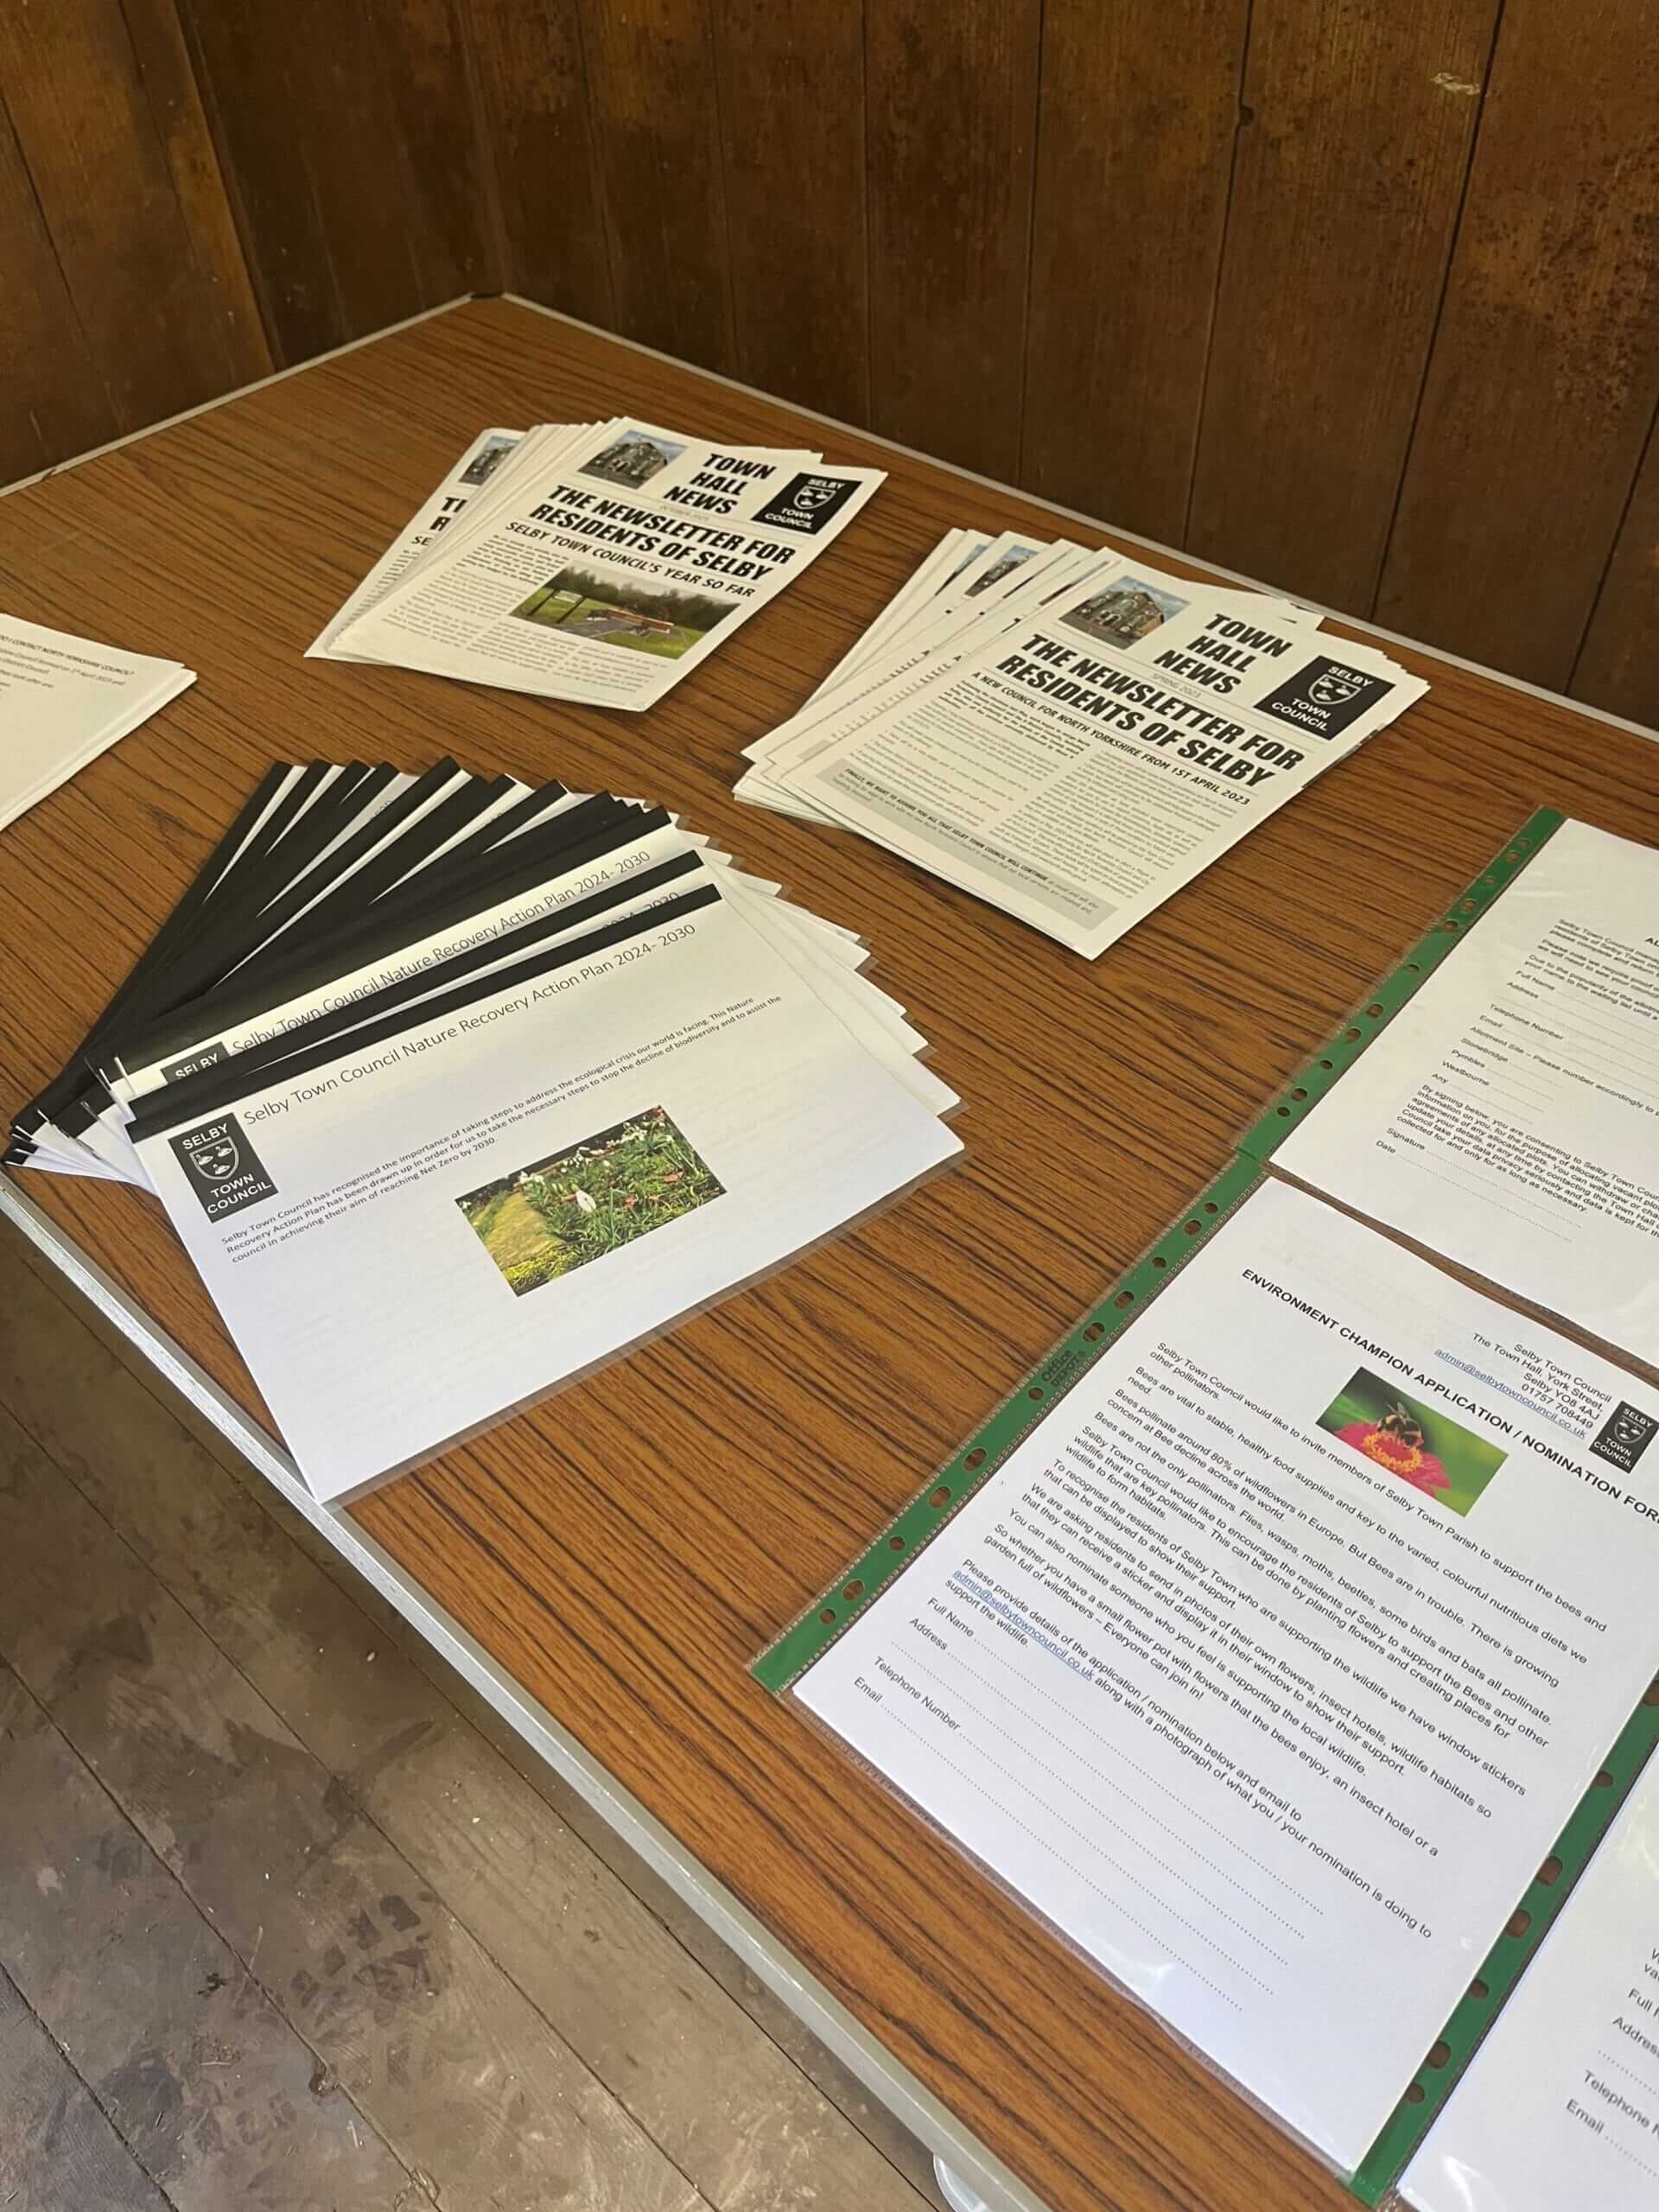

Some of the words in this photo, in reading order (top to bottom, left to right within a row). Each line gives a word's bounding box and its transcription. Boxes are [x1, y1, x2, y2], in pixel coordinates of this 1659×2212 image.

[702, 453, 777, 480] TOWN
[663, 486, 738, 514] NEWS
[690, 472, 747, 496] HALL
[807, 478, 845, 489] SELBY
[548, 485, 598, 510] THE
[591, 499, 746, 551] NEWSLETTER
[742, 539, 796, 564] FOR
[765, 512, 812, 529] COUNCIL
[781, 507, 815, 520] TOWN
[529, 504, 662, 552] RESIDENTS
[658, 542, 697, 561] OF
[690, 550, 774, 581] SELBY
[505, 522, 551, 540] SELBY
[550, 535, 593, 553] TOWN
[592, 548, 663, 573] COUNCIL'S
[664, 567, 702, 583] YEAR
[702, 578, 725, 589] SO
[725, 583, 756, 597] FAR
[1205, 613, 1293, 658] TOWN
[1186, 635, 1256, 673] HALL
[1154, 649, 1242, 694] NEWS
[1328, 666, 1374, 687] SELBY
[1020, 633, 1078, 668] THE
[1067, 658, 1245, 745] NEWSLETTER
[1237, 734, 1305, 771] FOR
[1271, 702, 1327, 731] COUNCIL
[1292, 697, 1332, 720] TOWN
[995, 654, 1146, 731] RESIDENTS
[1139, 722, 1186, 747] OF
[1177, 739, 1276, 787] SELBY
[980, 675, 1003, 689] NEW
[1001, 687, 1038, 709] COUNCIL
[1036, 704, 1058, 718] FOR
[1056, 714, 1091, 733] NORTH
[1090, 729, 1143, 757] YORKSHIRE
[1141, 753, 1172, 770] FROM
[1171, 767, 1192, 779] 1ST
[1189, 776, 1221, 793] APRIL
[1220, 789, 1250, 805] 2023
[276, 1007, 321, 1033] Town
[321, 978, 378, 1016] Council
[379, 957, 434, 987] Nature
[432, 925, 499, 962] Recovery
[499, 904, 549, 931] Action
[543, 889, 576, 910] Plan
[575, 868, 613, 895] 2024-
[615, 850, 652, 873] 2030
[1506, 982, 1539, 999] Address
[1516, 969, 1532, 980] Full
[1531, 976, 1556, 991] Name
[244, 1098, 289, 1125] Selby
[289, 1078, 339, 1103] Town
[340, 1048, 401, 1083] Council
[401, 1027, 458, 1057] Nature
[458, 996, 529, 1033] Recovery
[532, 976, 581, 1002] Action
[580, 962, 614, 981] Plan
[613, 943, 657, 966] 2024-
[657, 925, 696, 947] 2030
[1478, 1014, 1503, 1028] Email
[1490, 1003, 1530, 1026] Telephone
[1530, 1022, 1565, 1040] Number
[1451, 1049, 1485, 1068] Pymbles
[1460, 1038, 1509, 1063] Stonebridge
[1431, 1073, 1449, 1084] Any
[1442, 1060, 1491, 1086] Westbourne
[181, 1122, 227, 1150] SELBY
[1375, 1140, 1396, 1154] Date
[1386, 1127, 1426, 1150] Signature
[207, 1181, 272, 1214] COUNCIL
[210, 1173, 255, 1198] TOWN
[232, 1242, 267, 1263] council
[280, 1217, 326, 1242] achieving
[324, 1205, 346, 1220] their
[349, 1197, 367, 1209] aim
[368, 1190, 378, 1200] of
[379, 1173, 420, 1195] reaching
[419, 1164, 438, 1176] Net
[437, 1154, 460, 1168] Zero
[472, 1136, 498, 1152] 2030.
[1149, 1351, 1174, 1369] other
[1172, 1367, 1219, 1401] pollinators.
[1473, 1332, 1491, 1348] The
[1494, 1344, 1521, 1363] Town
[1521, 1359, 1542, 1377] Hall,
[1548, 1371, 1570, 1391] York
[1571, 1388, 1603, 1413] Street,
[1513, 1344, 1542, 1364] Selby
[1545, 1359, 1572, 1381] Town
[1573, 1376, 1612, 1403] Council
[1242, 1268, 1339, 1329] ENVIRONMENT
[1339, 1327, 1414, 1376] CHAMPION
[1413, 1374, 1514, 1434] APPLICATION
[1522, 1434, 1622, 1499] NOMINATION
[1623, 1495, 1659, 1524] FOR
[1521, 1383, 1554, 1404] 01757
[1554, 1402, 1594, 1429] 708449
[1523, 1372, 1553, 1394] Selby
[1555, 1389, 1578, 1408] YO8
[1578, 1405, 1600, 1421] 4AJ
[1623, 1408, 1653, 1427] SELBY
[1593, 1440, 1631, 1468] COUNCIL
[1605, 1437, 1632, 1457] TOWN
[1157, 1342, 1183, 1363] Selby
[1184, 1358, 1209, 1380] Town
[1209, 1376, 1245, 1402] Council
[1243, 1398, 1273, 1420] would
[1271, 1416, 1289, 1431] like
[1289, 1427, 1300, 1438] to
[1300, 1434, 1326, 1455] invite
[1326, 1452, 1372, 1485] members
[1373, 1483, 1387, 1492] of
[1385, 1489, 1415, 1512] Selby
[1416, 1507, 1444, 1530] Town
[1445, 1527, 1478, 1553] Parish
[1479, 1548, 1491, 1560] to
[1492, 1558, 1535, 1587] support
[1535, 1583, 1554, 1599] the
[1554, 1594, 1582, 1618] bees
[1584, 1616, 1607, 1632] and
[927, 1597, 948, 1616] Full
[945, 1611, 974, 1637] Name
[909, 1618, 948, 1650] Address
[1009, 1508, 1028, 1527] You
[1027, 1524, 1046, 1540] can
[1045, 1537, 1065, 1554] also
[1065, 1552, 1109, 1586] nominate
[1109, 1584, 1154, 1618] someone
[1154, 1616, 1176, 1635] who
[1174, 1631, 1196, 1649] you
[1196, 1645, 1217, 1664] feel
[1216, 1660, 1227, 1673] is
[1226, 1669, 1281, 1714] supporting
[1281, 1708, 1300, 1726] the
[1300, 1721, 1328, 1746] local
[1327, 1743, 1366, 1777] wildlife.
[854, 1676, 883, 1703] Email
[874, 1656, 921, 1700] Telephone
[920, 1695, 962, 1731] Number
[1628, 1987, 1652, 2012] Full
[1612, 2015, 1659, 2058] Addres
[1583, 2069, 1650, 2129] Telephone
[1566, 2098, 1605, 2134] Email
